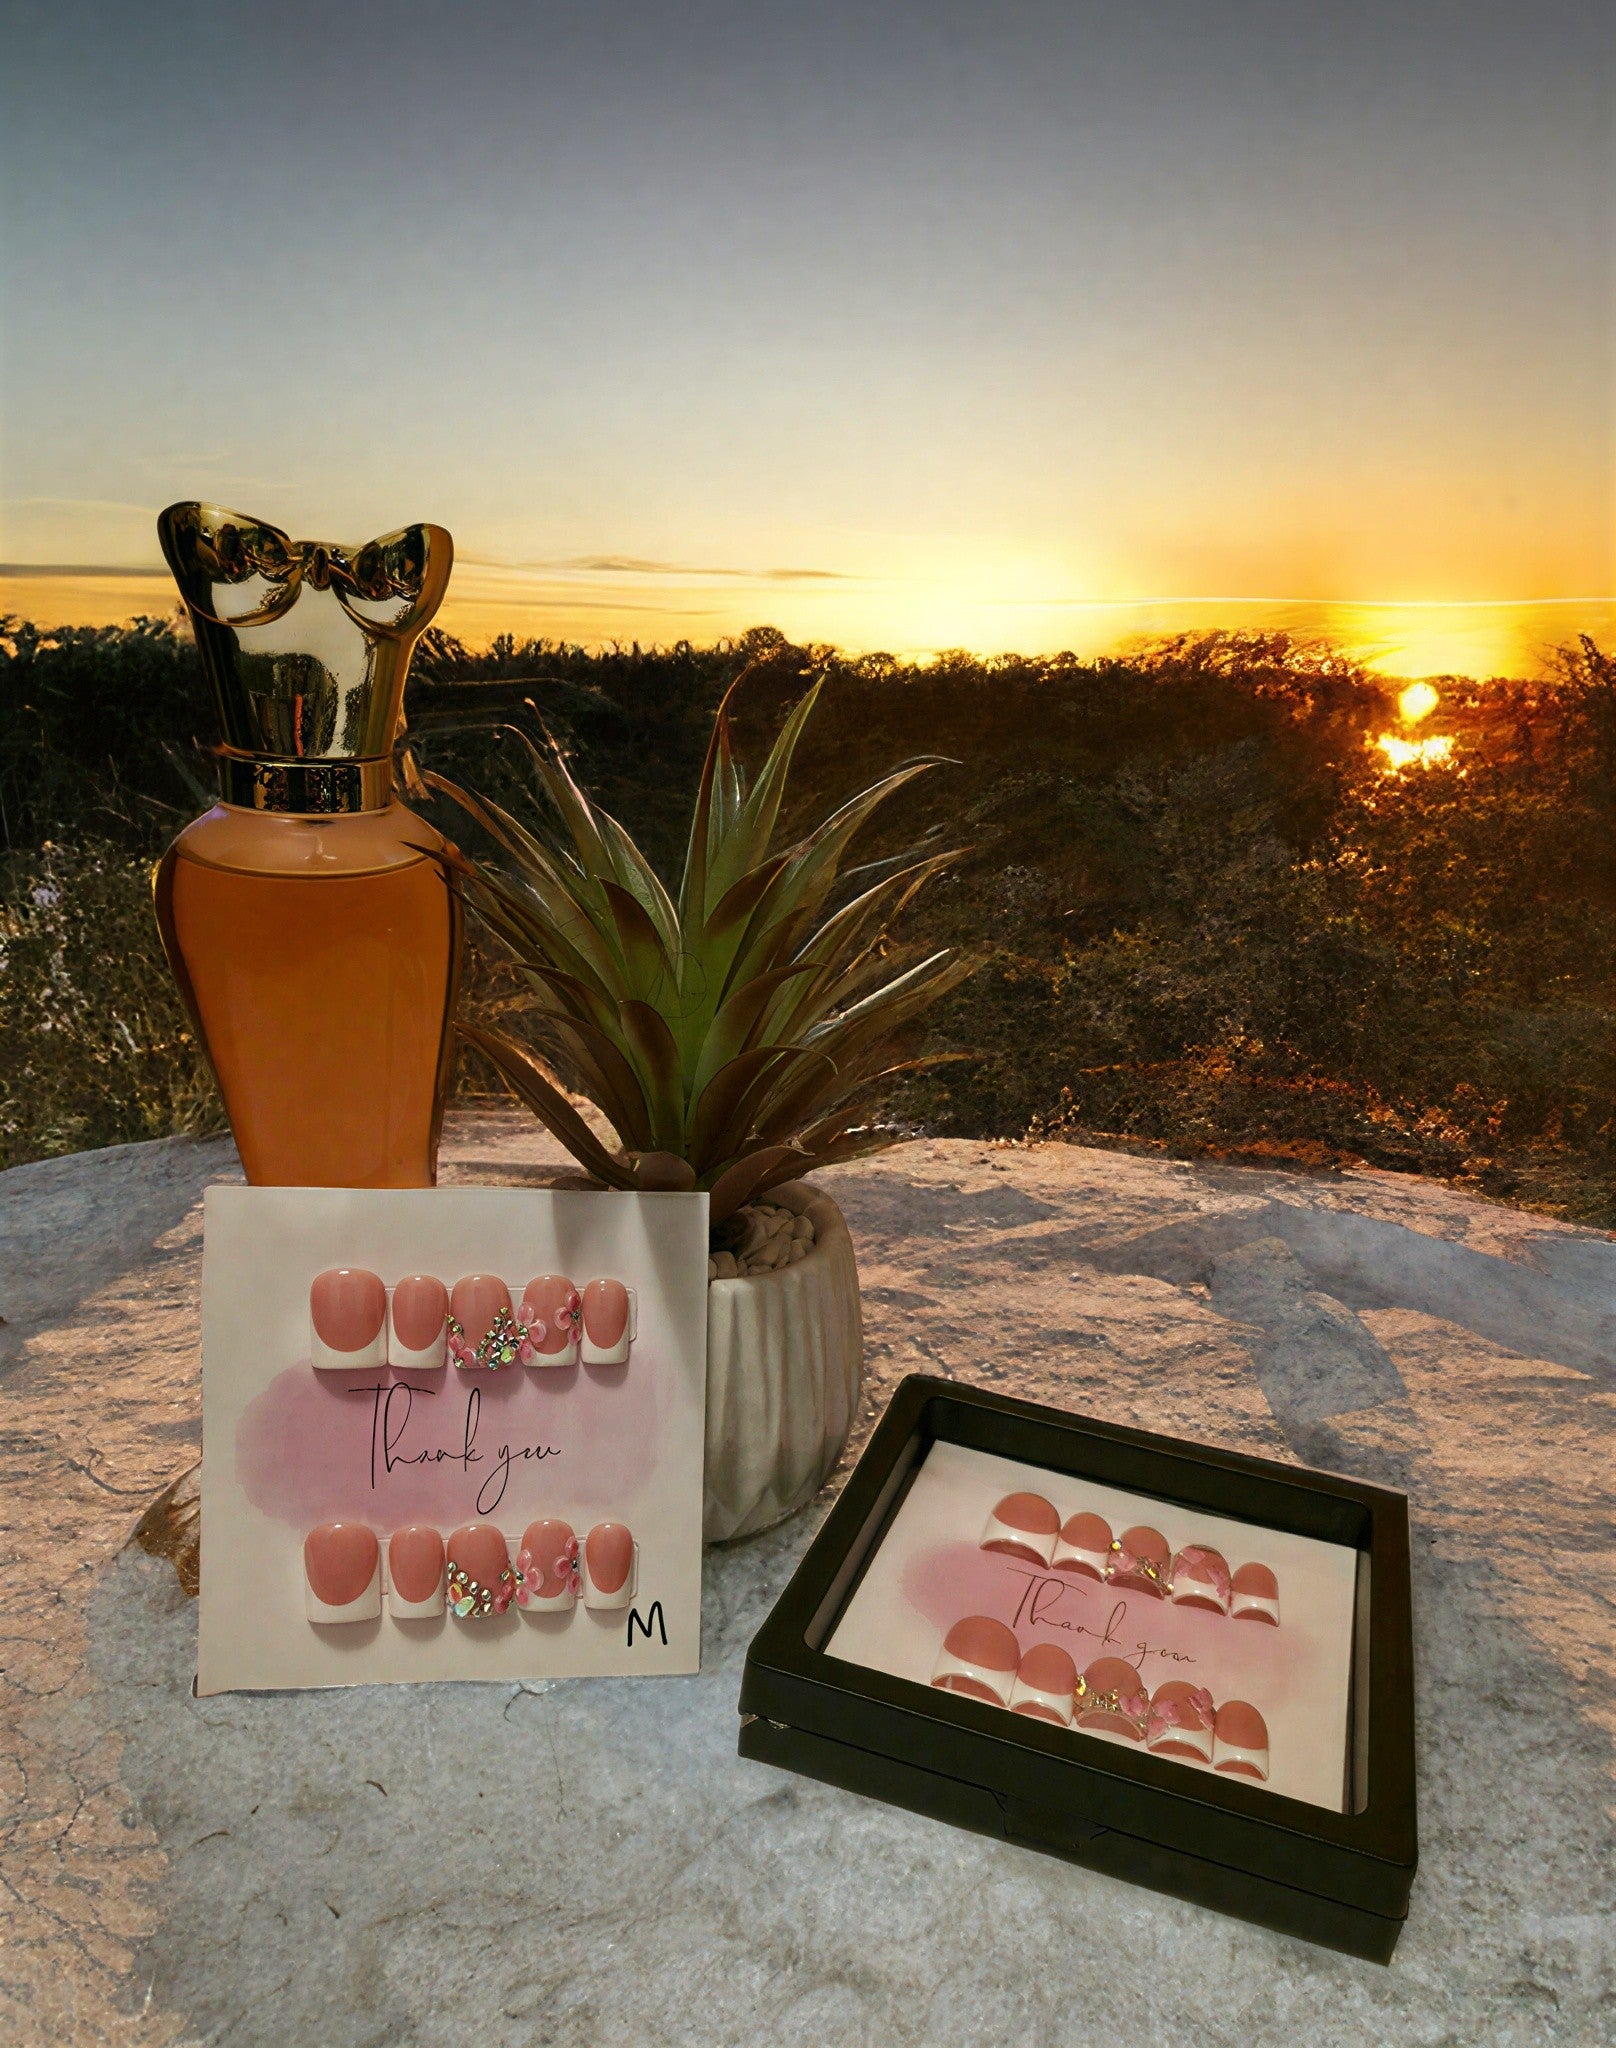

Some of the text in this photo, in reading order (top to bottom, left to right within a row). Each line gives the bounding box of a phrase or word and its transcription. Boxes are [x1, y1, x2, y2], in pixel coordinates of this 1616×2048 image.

[347, 1381, 562, 1515] Thank you
[626, 1600, 668, 1647] M
[1006, 1566, 1128, 1647] Thank
